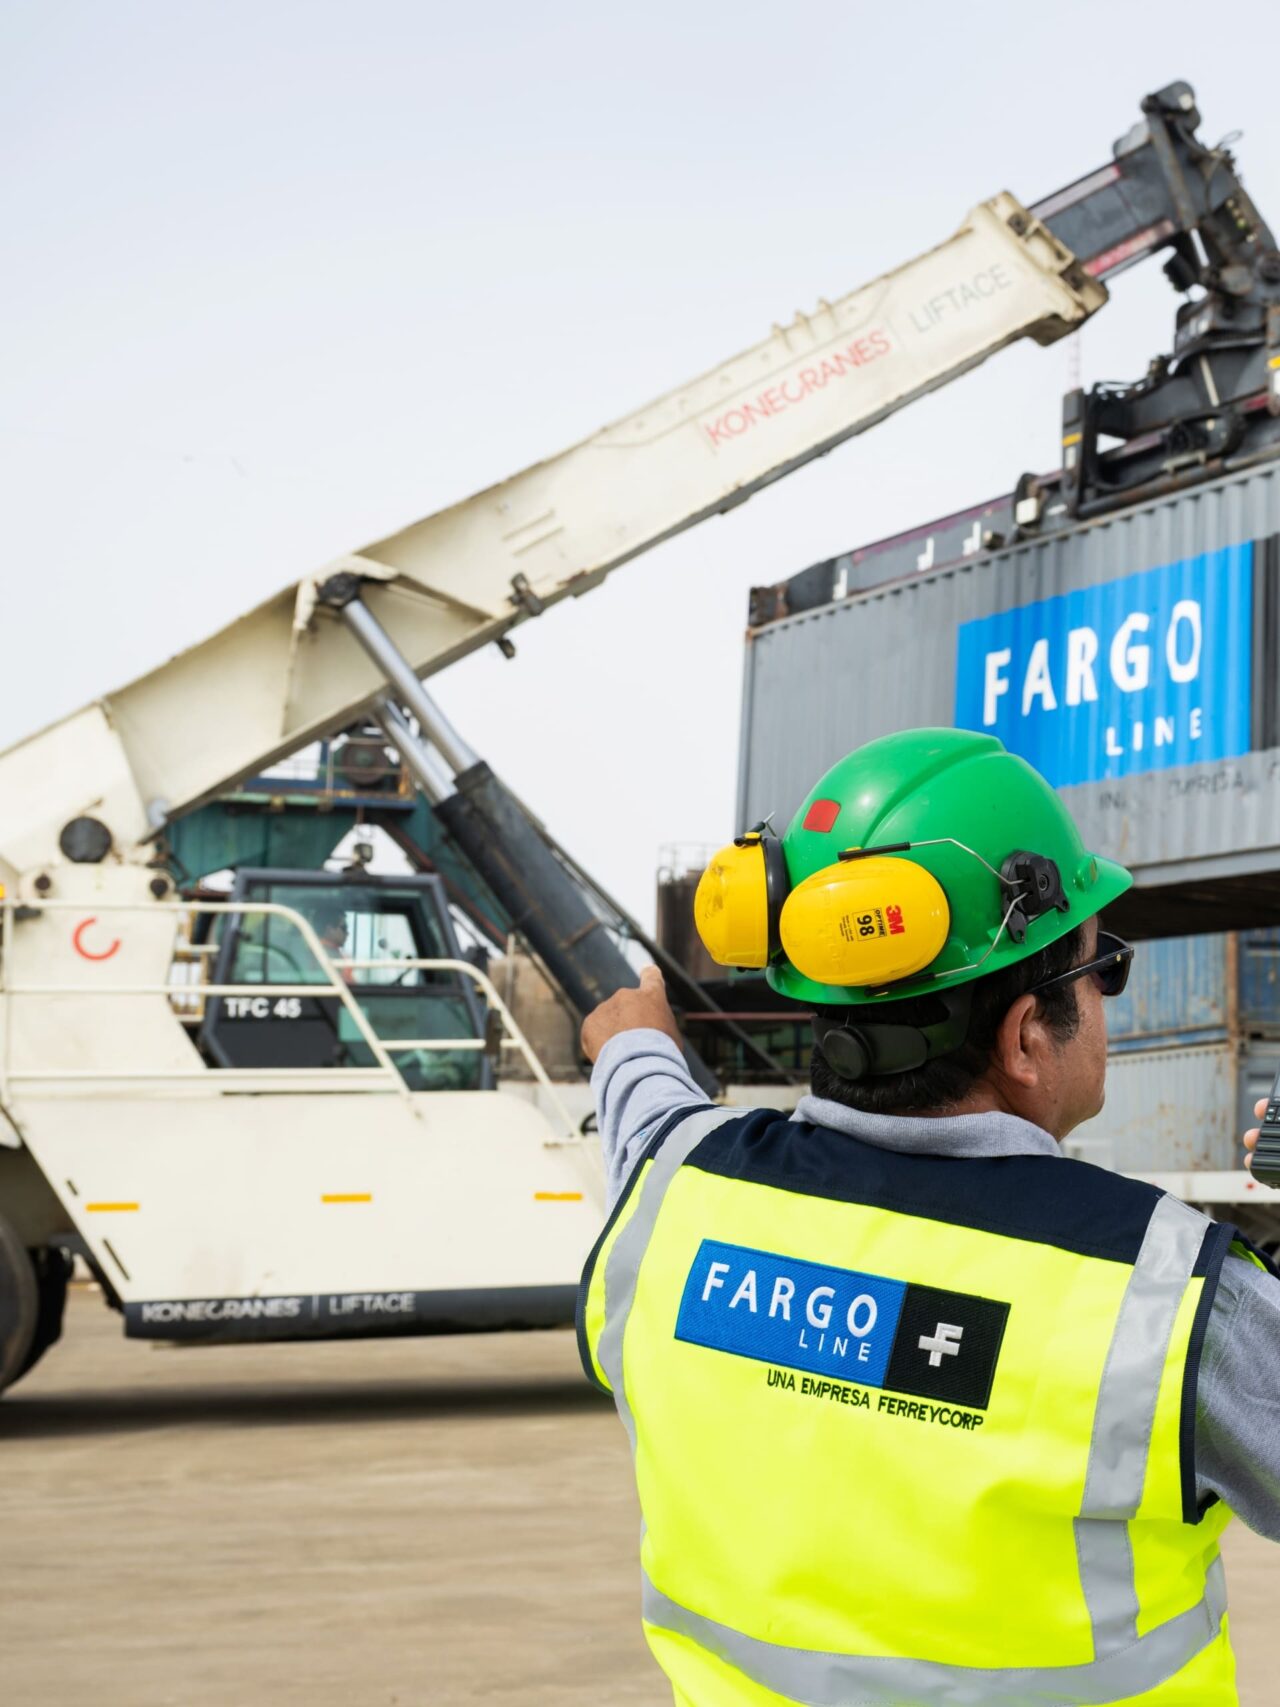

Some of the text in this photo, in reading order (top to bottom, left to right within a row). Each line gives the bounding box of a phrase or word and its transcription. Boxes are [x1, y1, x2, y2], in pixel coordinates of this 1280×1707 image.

[706, 264, 1012, 446] KONECRANES LIFTACE
[983, 599, 1202, 725] FARGO
[1106, 707, 1202, 756] LINE
[857, 914, 875, 937] 98
[874, 909, 886, 937] OPTIME
[886, 905, 905, 935] 3M
[224, 997, 302, 1018] TFC 45
[142, 1293, 416, 1322] KONECRANES LIFTACE
[701, 1261, 878, 1338] FARGO
[799, 1329, 872, 1362] LINE
[767, 1369, 984, 1432] UNA EMPRESA FERREYCORP
